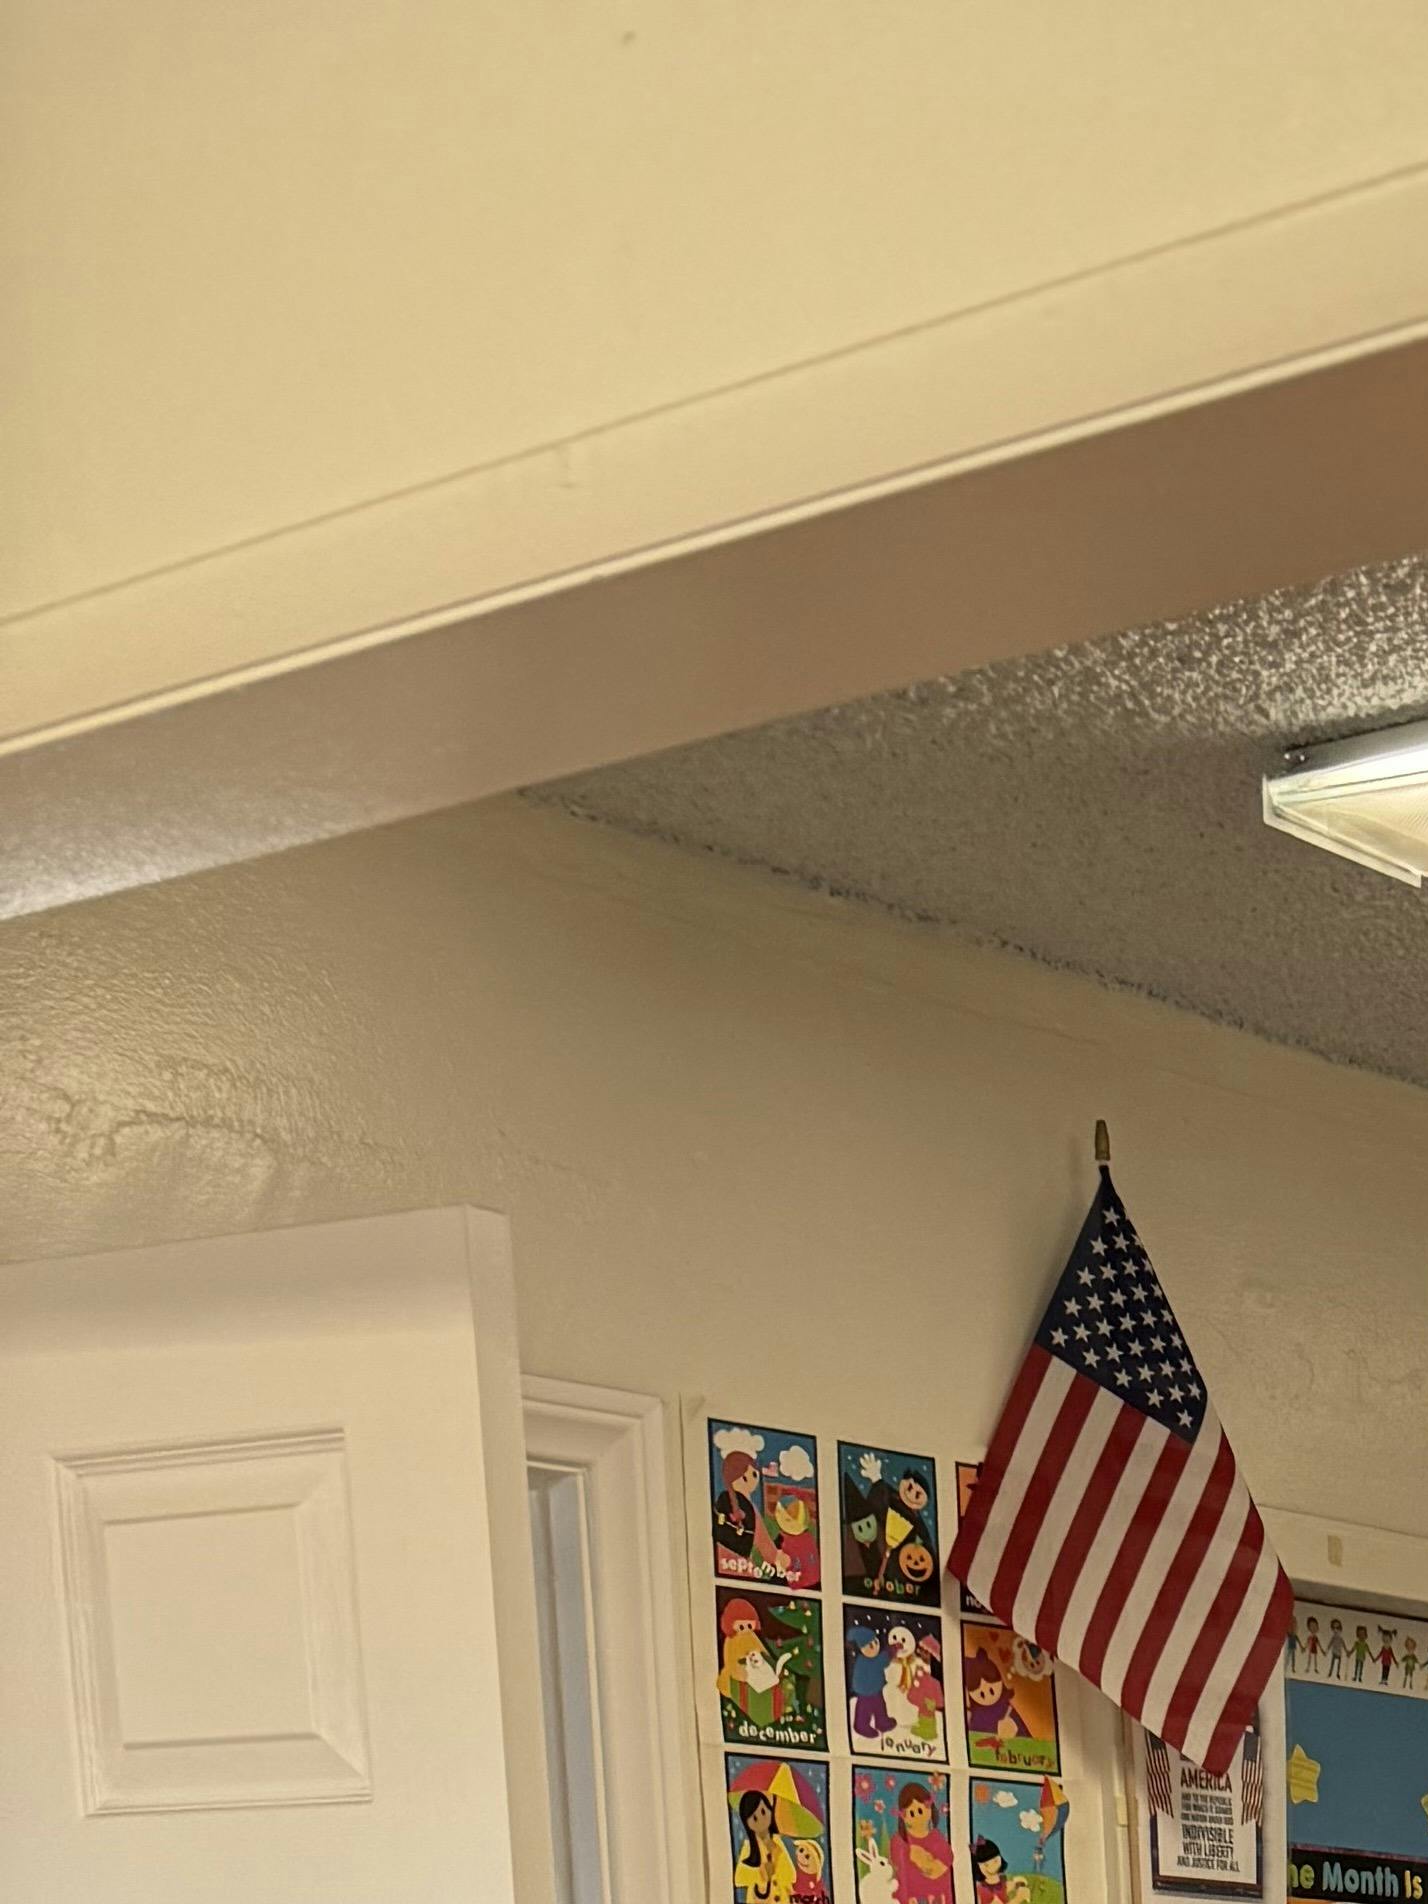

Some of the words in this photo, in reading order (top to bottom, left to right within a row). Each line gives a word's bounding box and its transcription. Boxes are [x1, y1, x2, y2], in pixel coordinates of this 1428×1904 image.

[739, 1721, 817, 1745] december
[880, 1731, 936, 1757] january
[1322, 1861, 1399, 1897] Month
[1404, 1870, 1423, 1899] Is
